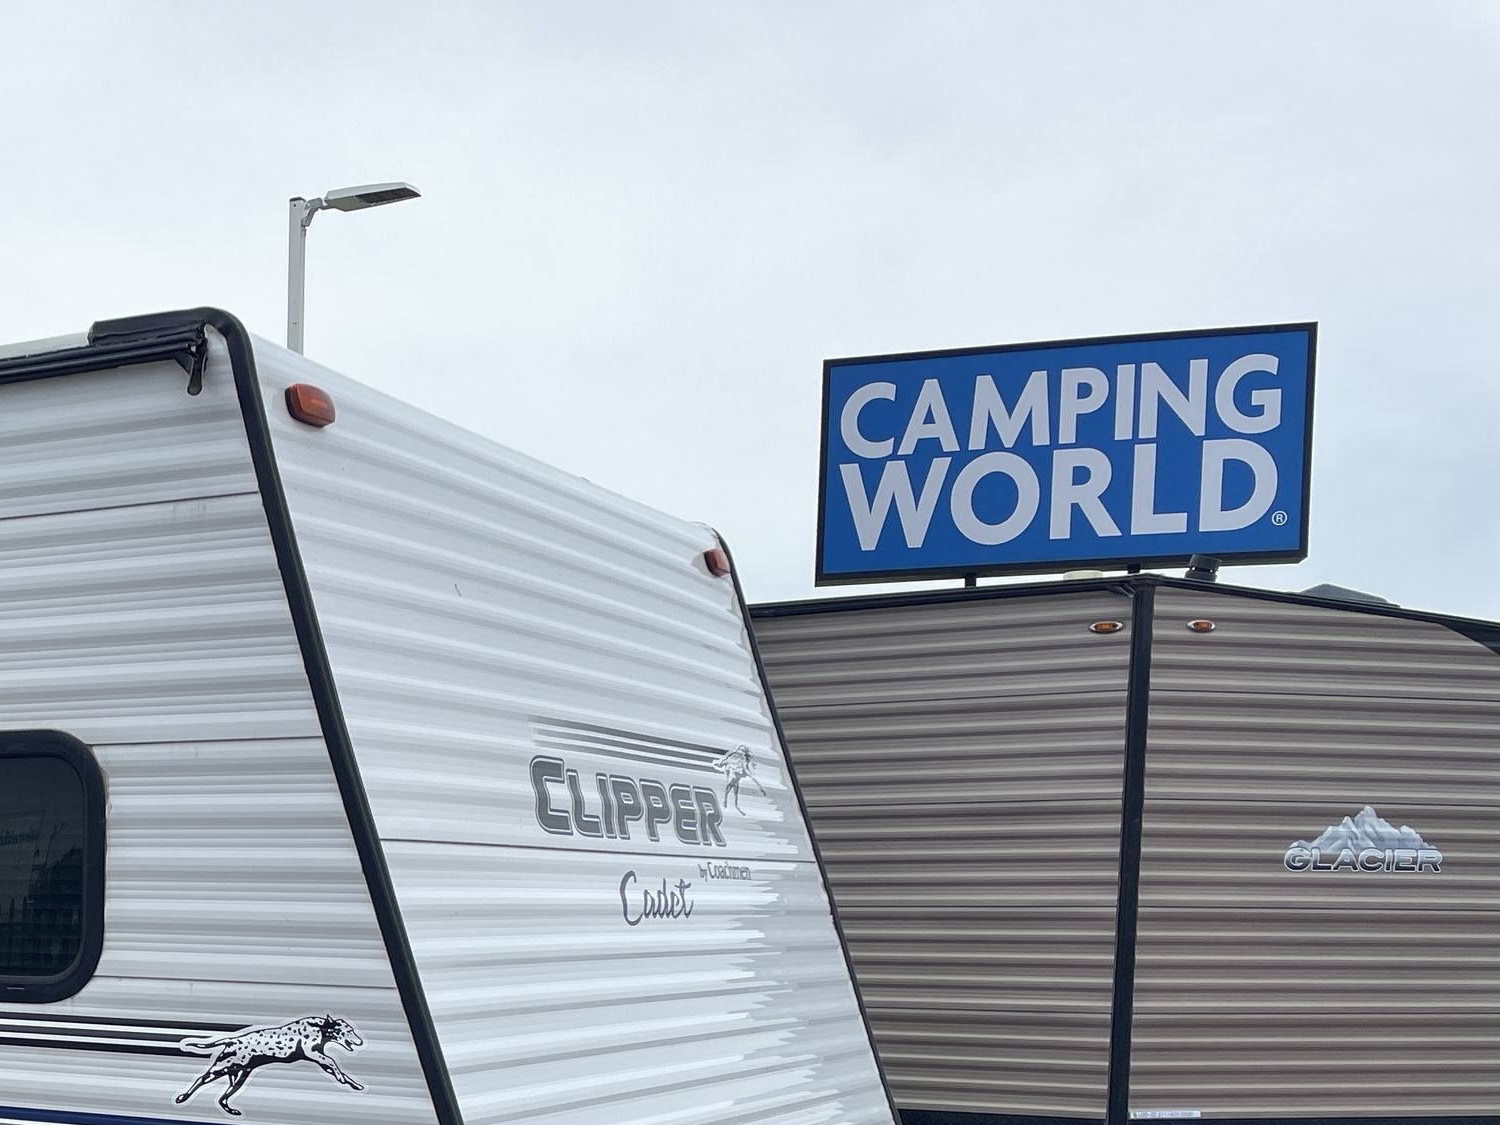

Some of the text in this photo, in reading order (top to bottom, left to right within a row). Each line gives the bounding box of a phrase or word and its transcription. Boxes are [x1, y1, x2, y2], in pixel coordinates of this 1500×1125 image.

[840, 353, 1282, 459] CAMPING
[839, 438, 1279, 551] WORLD
[529, 755, 727, 847] CLIPPER
[708, 861, 752, 881] Coachmen
[1284, 845, 1443, 873] GLACIER
[620, 871, 694, 926] Cadet
